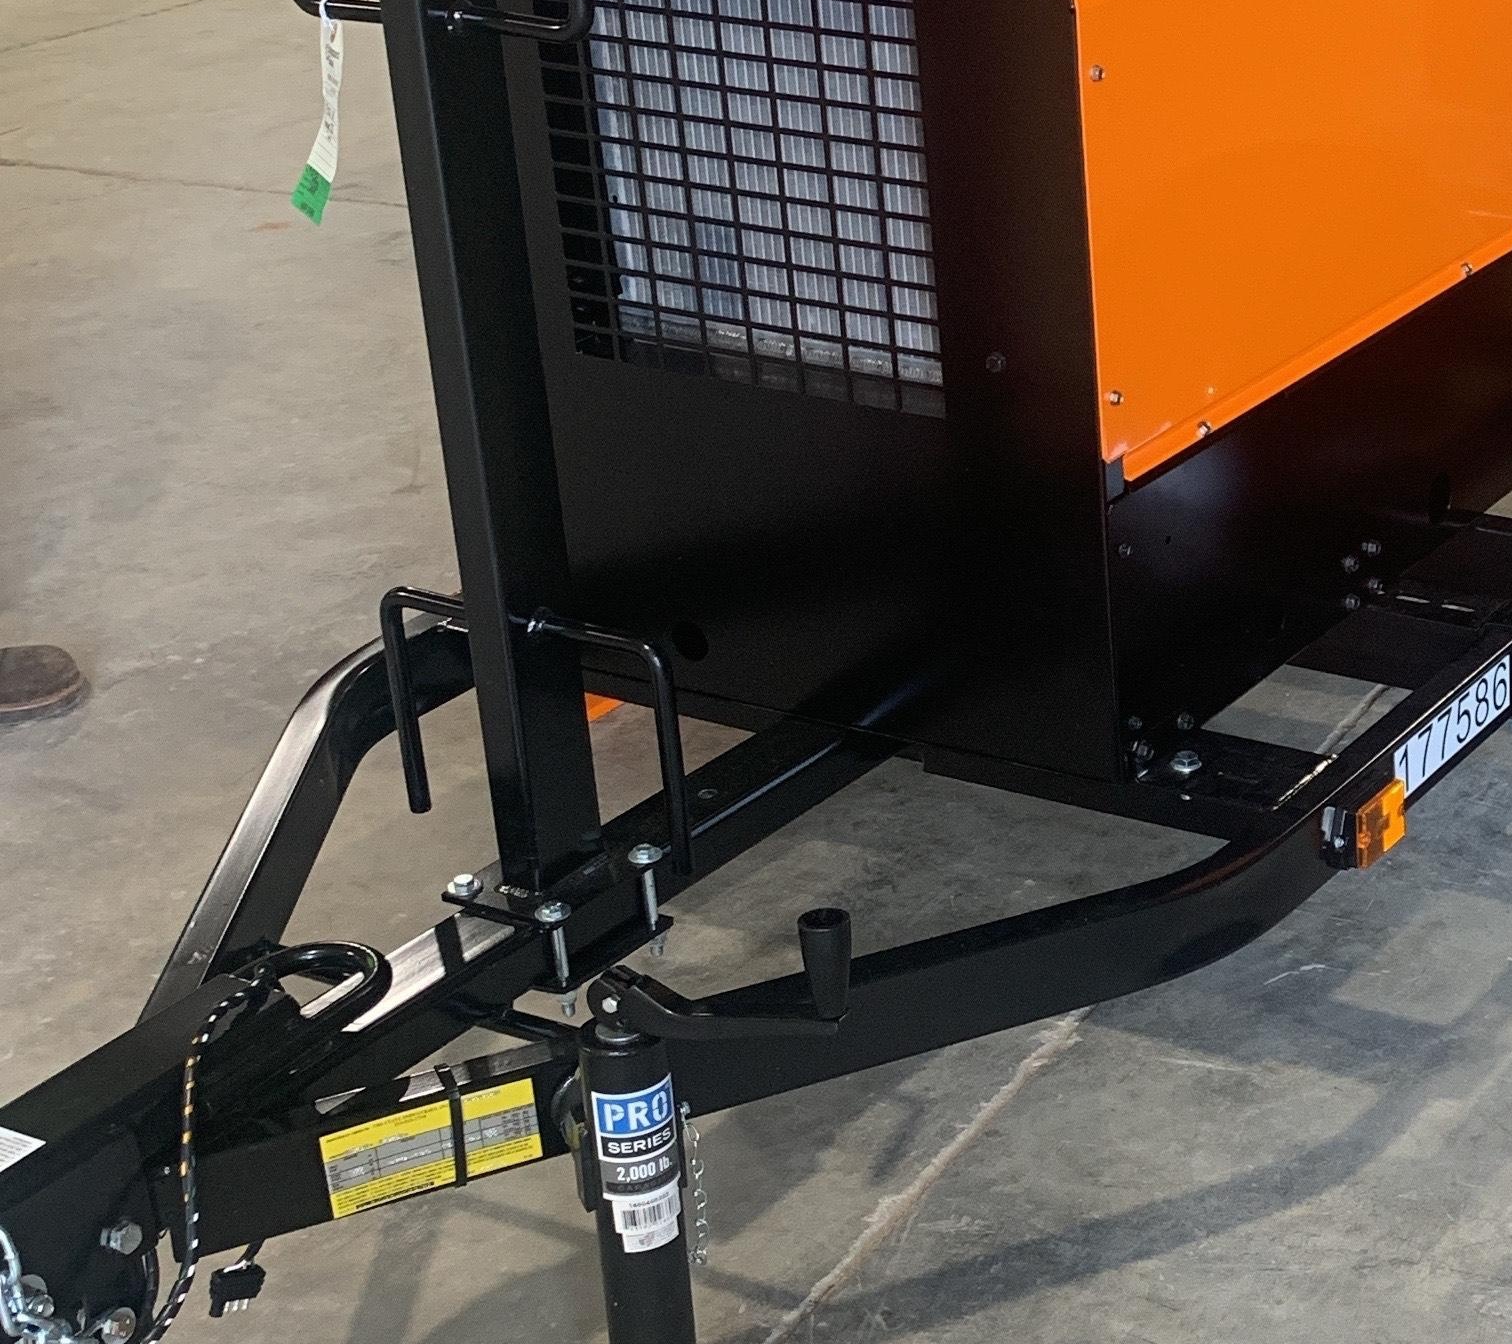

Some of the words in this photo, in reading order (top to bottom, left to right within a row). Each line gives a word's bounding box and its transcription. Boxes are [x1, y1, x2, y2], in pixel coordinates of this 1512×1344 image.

[1399, 661, 1508, 792] 177586
[603, 1090, 669, 1132] PRO
[607, 1127, 672, 1155] SERIES
[616, 1161, 656, 1183] 2,000
